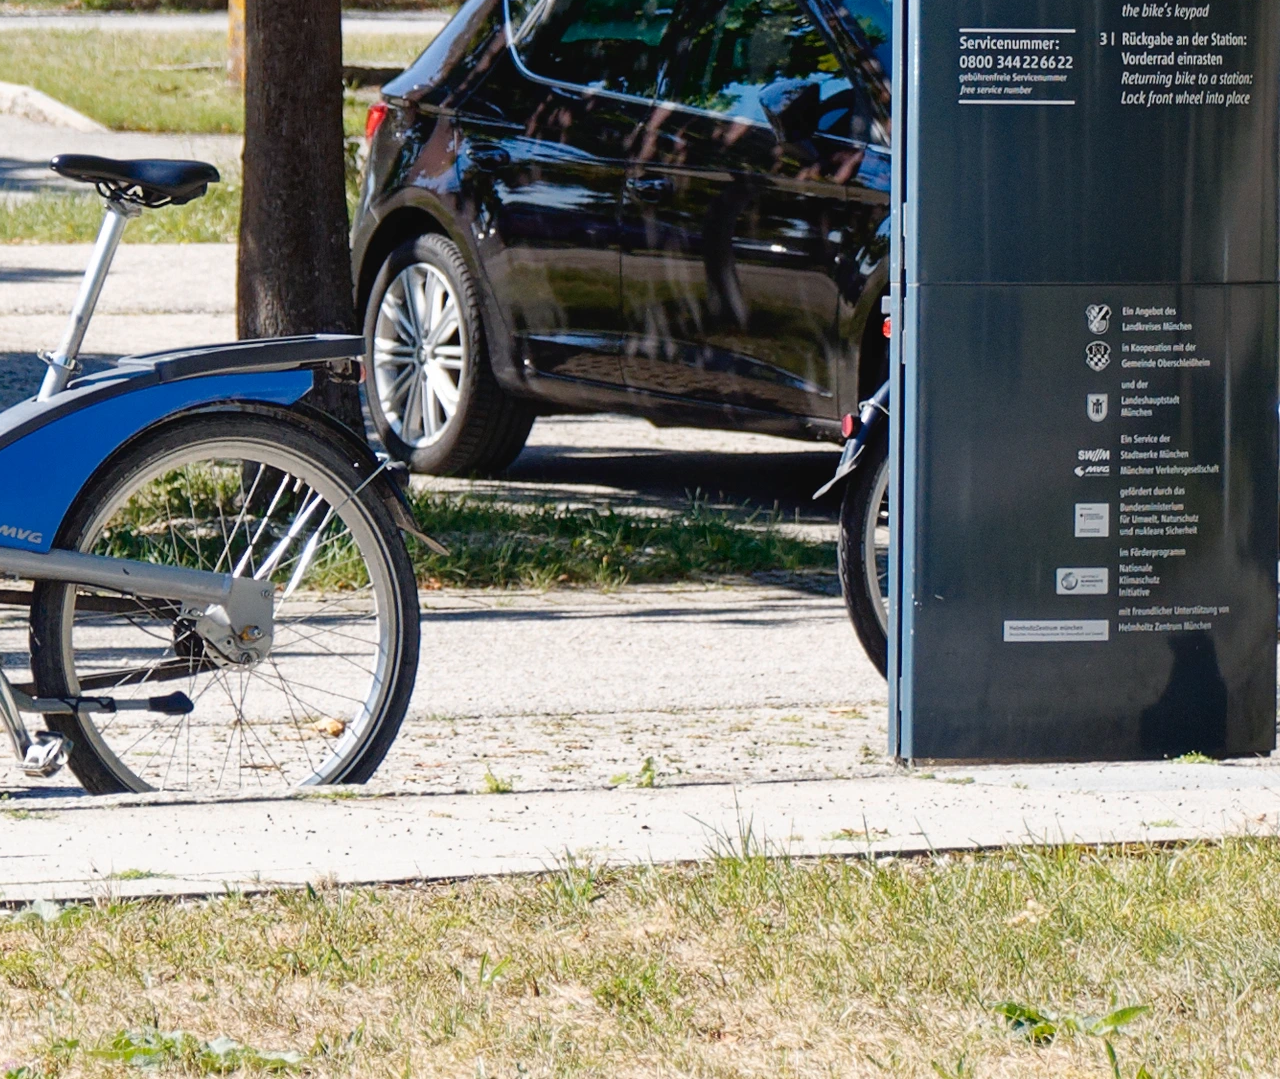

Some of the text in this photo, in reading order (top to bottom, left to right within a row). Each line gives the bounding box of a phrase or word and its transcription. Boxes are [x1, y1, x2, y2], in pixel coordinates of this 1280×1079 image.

[1122, 5, 1139, 17] the
[1174, 5, 1209, 20] keypad
[959, 36, 1059, 50] Servicenummer:
[1122, 32, 1173, 48] Rückgabe
[1176, 36, 1189, 46] an
[1192, 33, 1208, 46] der
[1211, 33, 1247, 46] Station:
[959, 55, 993, 68] 0800
[1122, 52, 1222, 65] Vorderrad einrasten
[959, 72, 1067, 83] gebührenfreie Servicenummer
[1121, 72, 1253, 87] Returning bike to a station:
[959, 85, 1032, 95] free service number
[1121, 92, 1250, 107] Lock front wheel into place
[1122, 307, 1176, 318] Ein Angebot des
[1122, 322, 1192, 331] Landkreises München
[1131, 343, 1171, 353] Kooperation
[1173, 343, 1184, 352] mit
[1186, 343, 1196, 352] der
[1122, 359, 1156, 368] Gemeinde
[1122, 380, 1148, 389] und der
[1121, 396, 1180, 406] Landeshauptstadt
[1121, 408, 1152, 416] München
[1121, 435, 1170, 443] Ein Service der
[1120, 450, 1188, 459] Stadtwerke München
[1120, 466, 1154, 475] Münchner
[1120, 486, 1185, 498] gefördert durch das
[1120, 502, 1184, 512] Bundesministerium
[1120, 515, 1130, 524] für
[1161, 514, 1199, 523] Naturschutz
[1120, 526, 1197, 535] und nukleare Sicherheit
[1130, 547, 1186, 558] Förderprogramm
[1119, 564, 1153, 573] Nationale
[1119, 576, 1160, 585] Klimaschutz
[1119, 588, 1150, 597] Initiative
[1119, 605, 1229, 616] mit freundlicher Unterstützung von
[1119, 621, 1211, 632] Helmholtz Zentrum München
